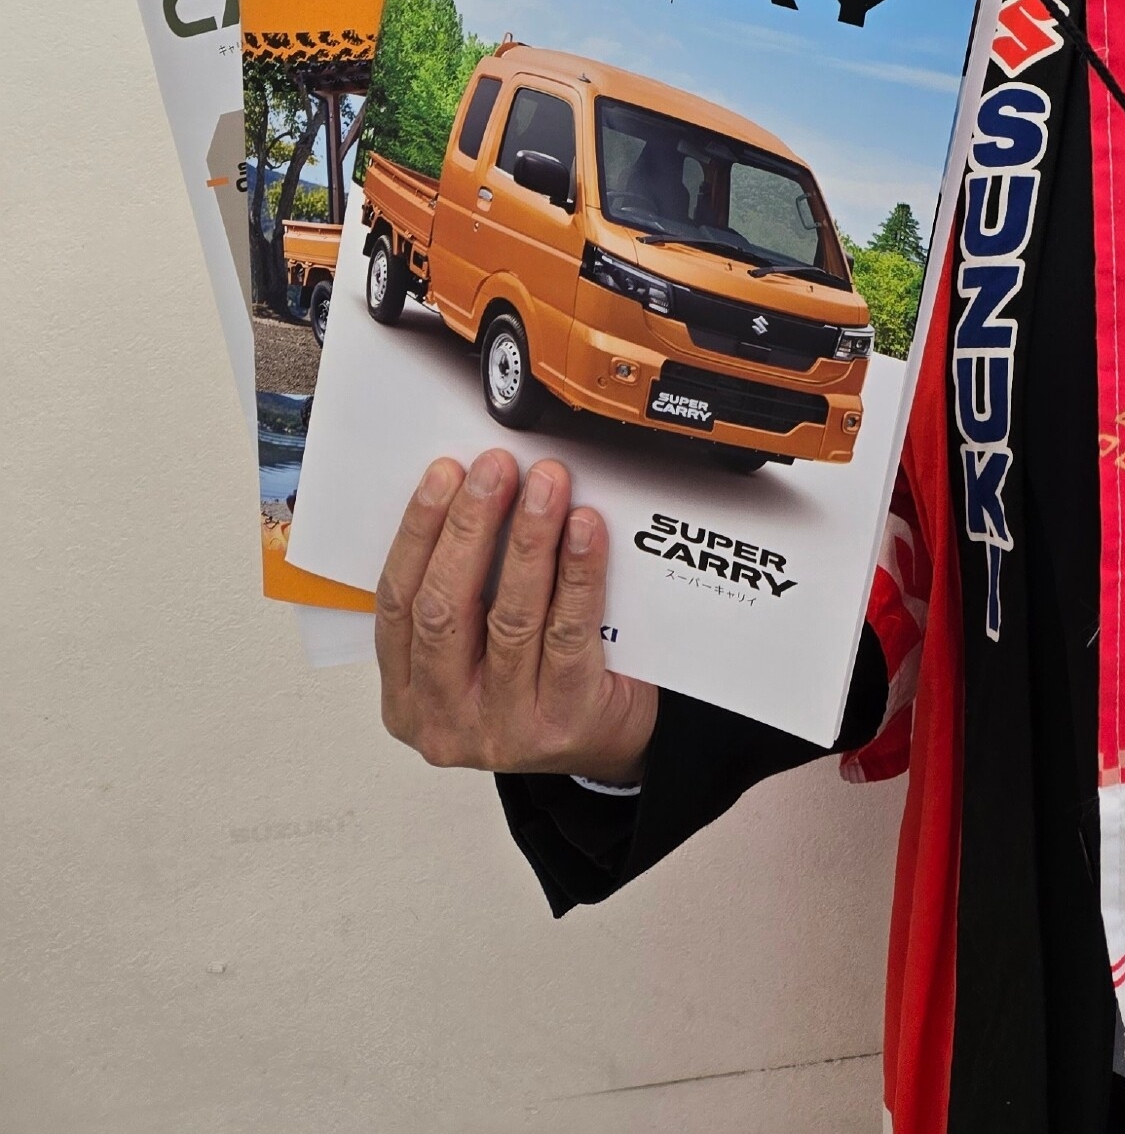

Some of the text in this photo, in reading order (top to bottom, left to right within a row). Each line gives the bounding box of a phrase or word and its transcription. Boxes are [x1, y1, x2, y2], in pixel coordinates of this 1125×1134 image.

[953, 81, 1047, 642] SUZUKI
[652, 400, 712, 422] CARRY
[658, 391, 709, 412] SUPER
[634, 530, 798, 598] CARRY
[651, 513, 786, 574] SUPER
[665, 568, 757, 606] スーパーキャリイ
